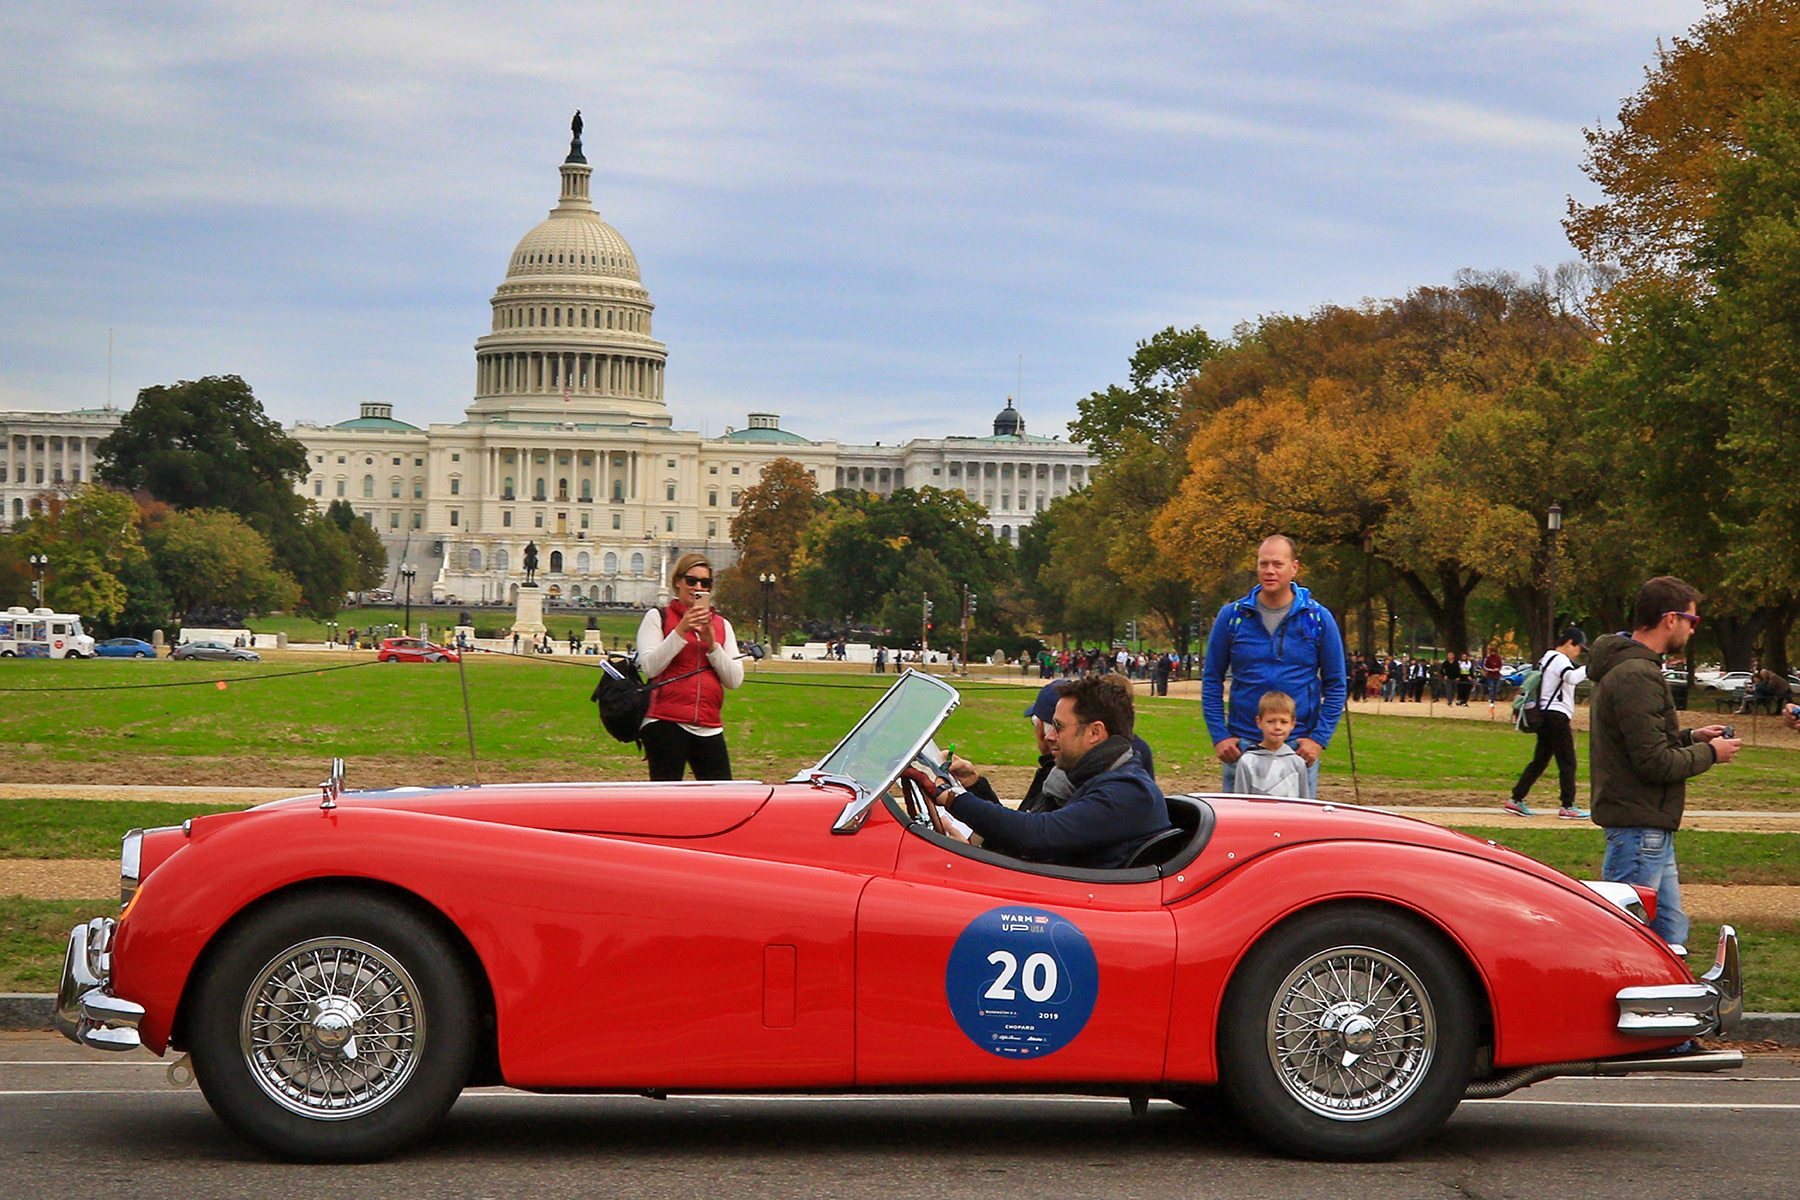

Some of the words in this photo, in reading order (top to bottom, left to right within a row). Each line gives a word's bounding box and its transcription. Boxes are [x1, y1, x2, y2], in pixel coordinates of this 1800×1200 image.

[1001, 914, 1033, 923] WARM
[1002, 924, 1029, 932] UP
[1031, 925, 1044, 933] USA
[984, 950, 1058, 1002] 20
[1038, 1012, 1059, 1020] 2019
